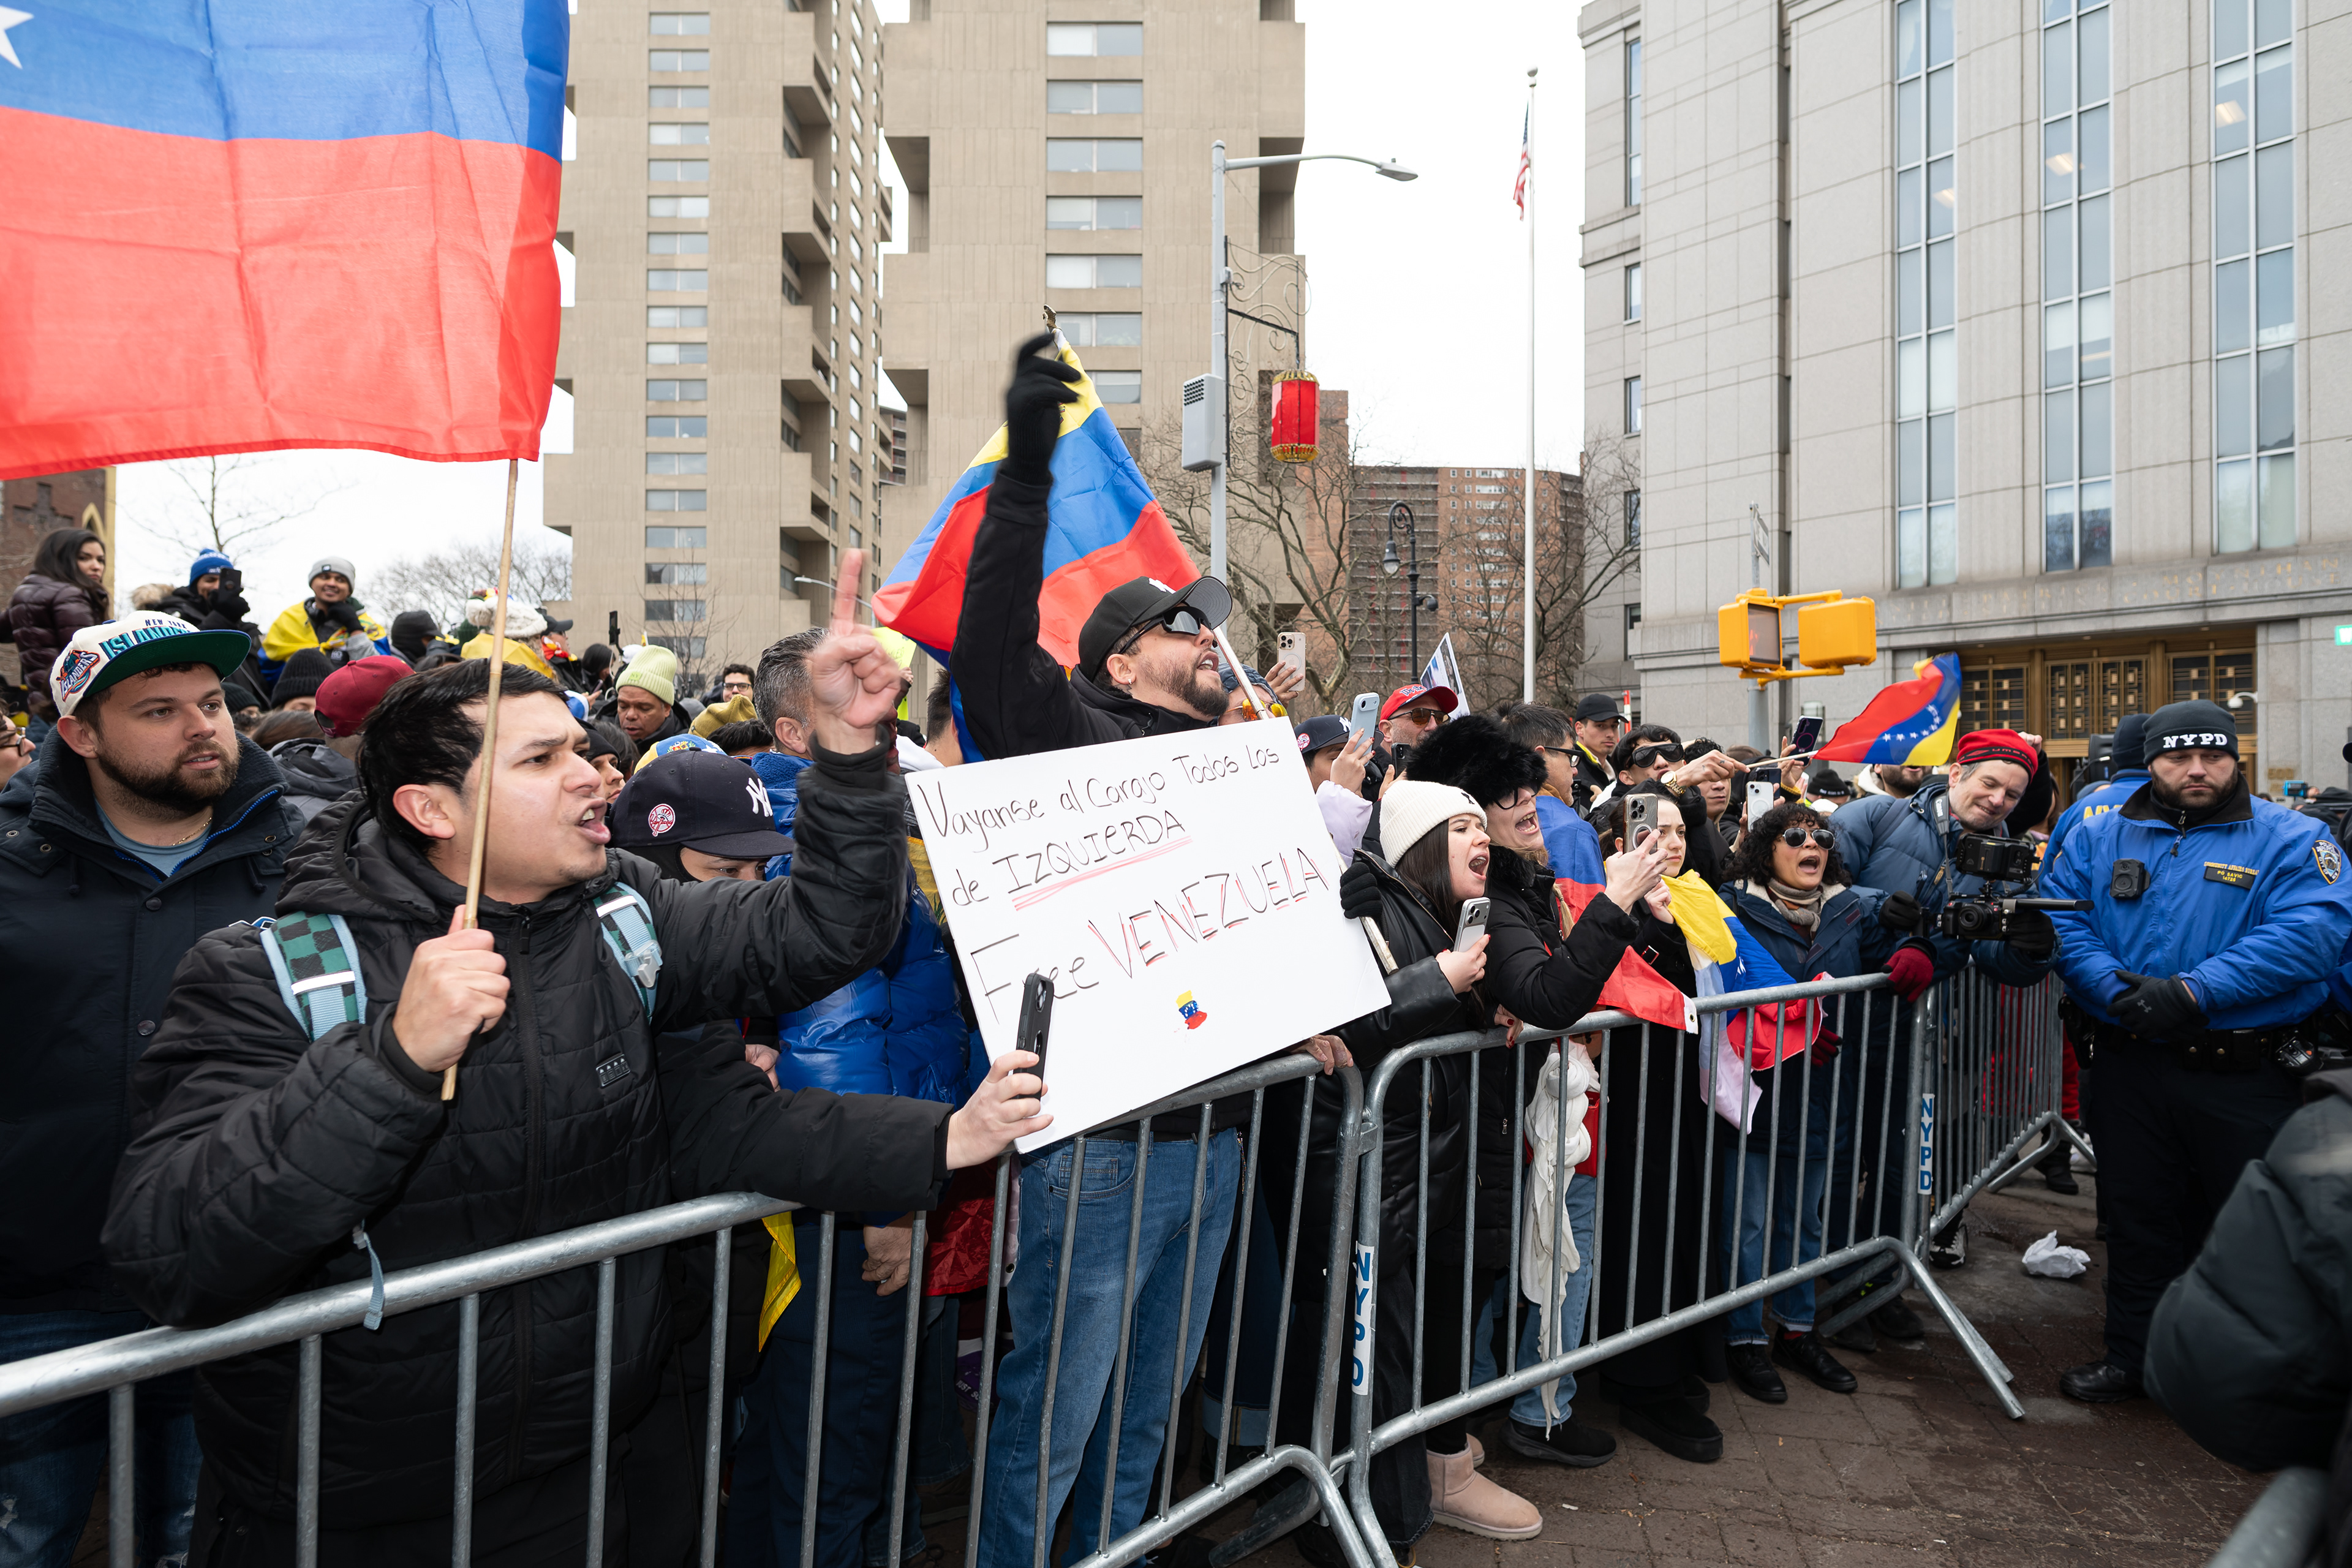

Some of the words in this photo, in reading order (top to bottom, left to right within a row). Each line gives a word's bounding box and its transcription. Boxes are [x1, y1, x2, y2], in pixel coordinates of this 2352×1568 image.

[2162, 557, 2339, 586] MOYNIHAN
[99, 625, 190, 661] ISLAND
[60, 651, 99, 696] ISLANDERS
[2162, 733, 2228, 748] NYPD
[917, 780, 1044, 853] Vayanse
[1060, 780, 1084, 813] al
[1087, 772, 1165, 804] Carajo
[1172, 755, 1238, 785] Todos
[1246, 745, 1280, 769] Los
[952, 869, 989, 907] de
[2228, 864, 2245, 873] AFFAIRS
[970, 933, 1099, 1024] Fee
[1088, 848, 1329, 978] VENEZUELA
[1920, 1098, 1933, 1190] NYPD
[1351, 1249, 1371, 1387] NYPD
